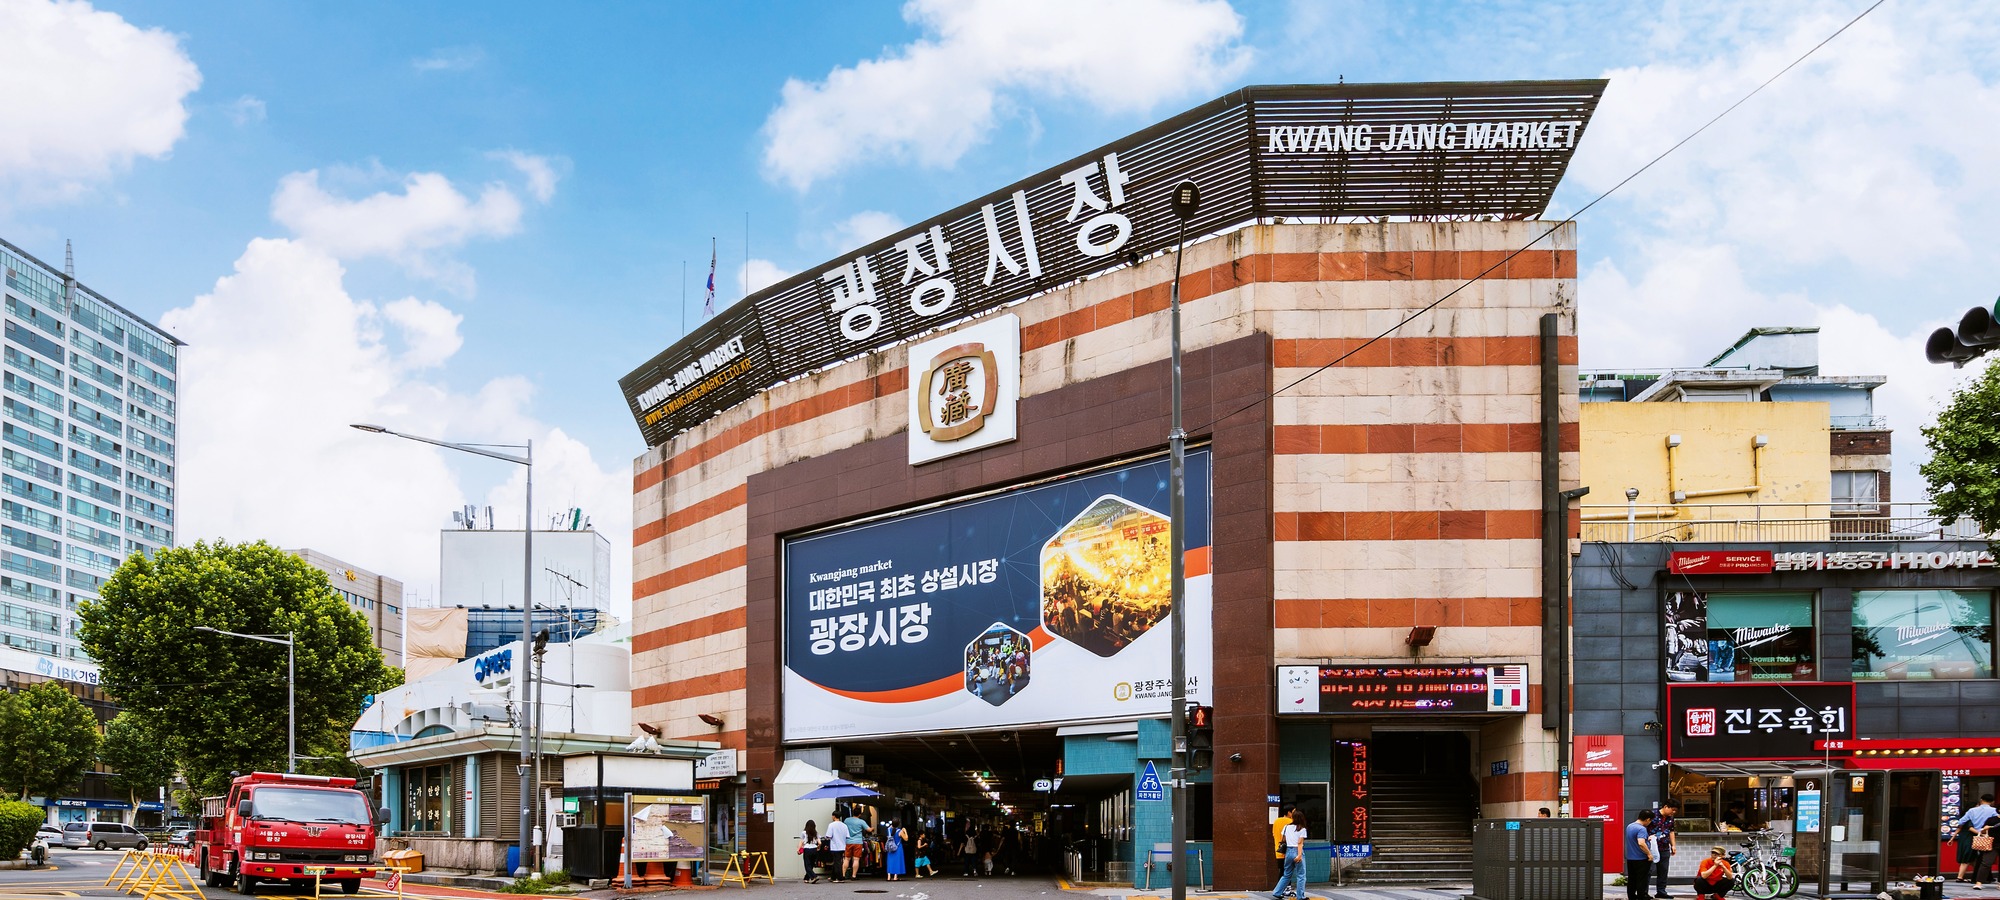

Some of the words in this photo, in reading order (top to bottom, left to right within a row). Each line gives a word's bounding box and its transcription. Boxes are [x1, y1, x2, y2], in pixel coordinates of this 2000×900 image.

[1268, 122, 1373, 153] KWANG
[1380, 121, 1456, 152] JANG
[1464, 120, 1582, 150] MARKET
[822, 151, 1133, 341] 광장시장
[636, 377, 676, 411] KWANG
[674, 361, 701, 392] JANG
[699, 335, 746, 377] MARKET
[809, 566, 859, 583] Kwangjang
[859, 559, 893, 574] market
[1678, 555, 1711, 567] Milwaukee
[1774, 551, 1824, 571] 밀워키
[1826, 551, 1889, 570] 전동공구
[809, 580, 876, 611] 대한민국
[880, 574, 916, 599] 최초
[920, 558, 999, 593] 상설시장
[809, 602, 932, 656] 광장시장
[1732, 622, 1791, 644] Milwaukee
[1895, 621, 1951, 642] Milwaukee
[57, 665, 98, 683] IBK기업
[1134, 676, 1198, 693] 광장주사
[1135, 691, 1156, 699] KWANG
[1724, 705, 1845, 735] 진주육회
